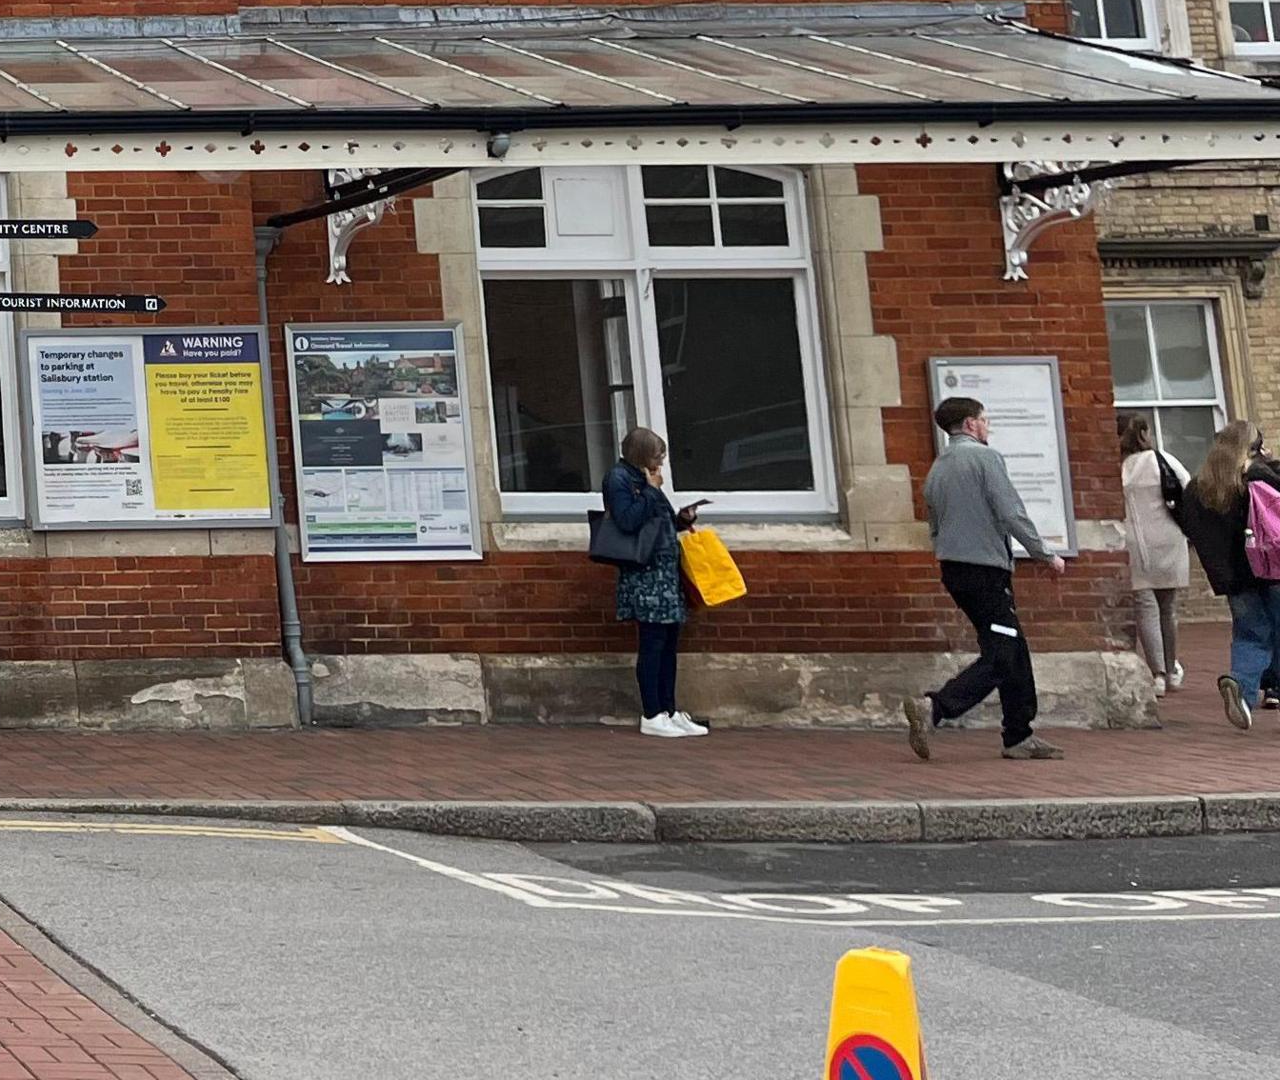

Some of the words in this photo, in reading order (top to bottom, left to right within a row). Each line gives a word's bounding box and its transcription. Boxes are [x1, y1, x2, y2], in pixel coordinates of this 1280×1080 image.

[21, 224, 69, 234] CENTRE
[47, 298, 126, 309] INFORMATION
[182, 336, 244, 348] WARNING
[40, 351, 85, 360] Temporary
[87, 351, 124, 360] changes
[40, 363, 50, 371] to
[51, 363, 84, 372] parking
[41, 374, 81, 384] Salisbury
[83, 374, 114, 382] station
[480, 872, 964, 915] DROP
